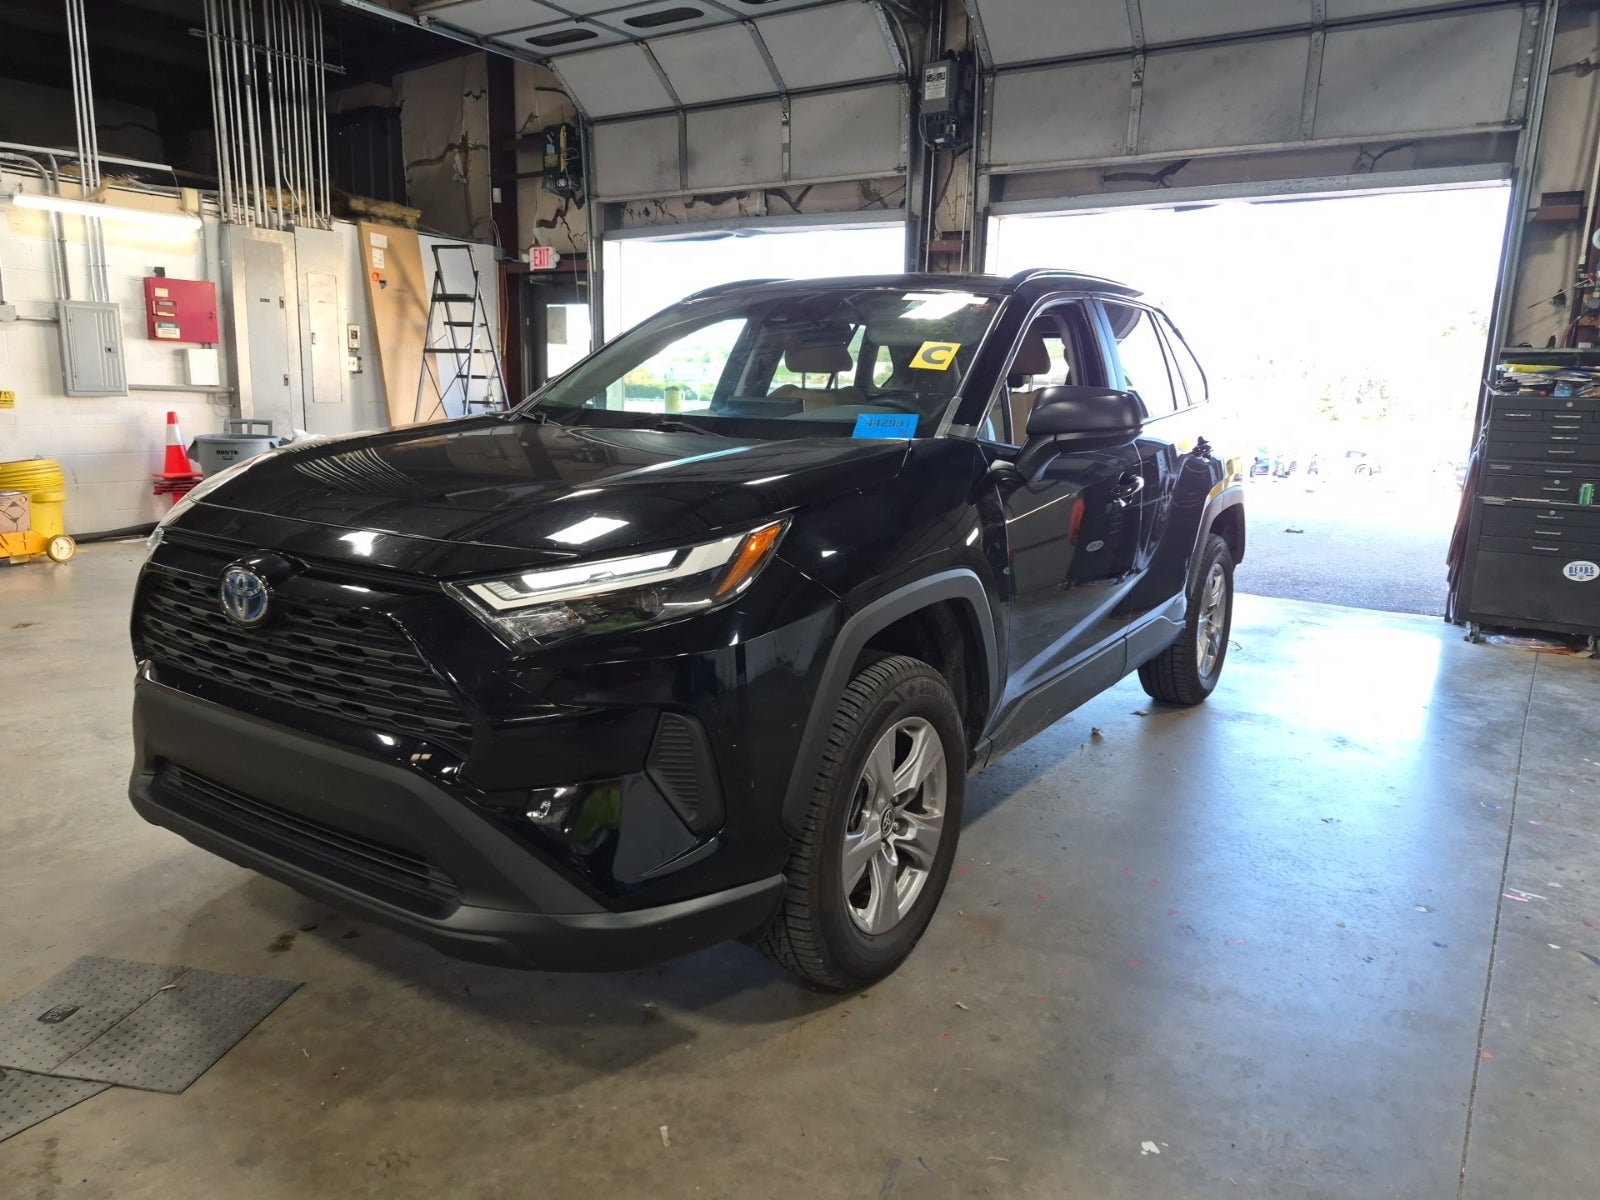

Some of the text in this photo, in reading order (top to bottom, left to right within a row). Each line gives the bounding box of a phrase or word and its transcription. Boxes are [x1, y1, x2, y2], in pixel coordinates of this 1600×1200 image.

[533, 248, 550, 267] EXIT
[922, 346, 952, 364] C
[1568, 566, 1594, 575] BEARS
